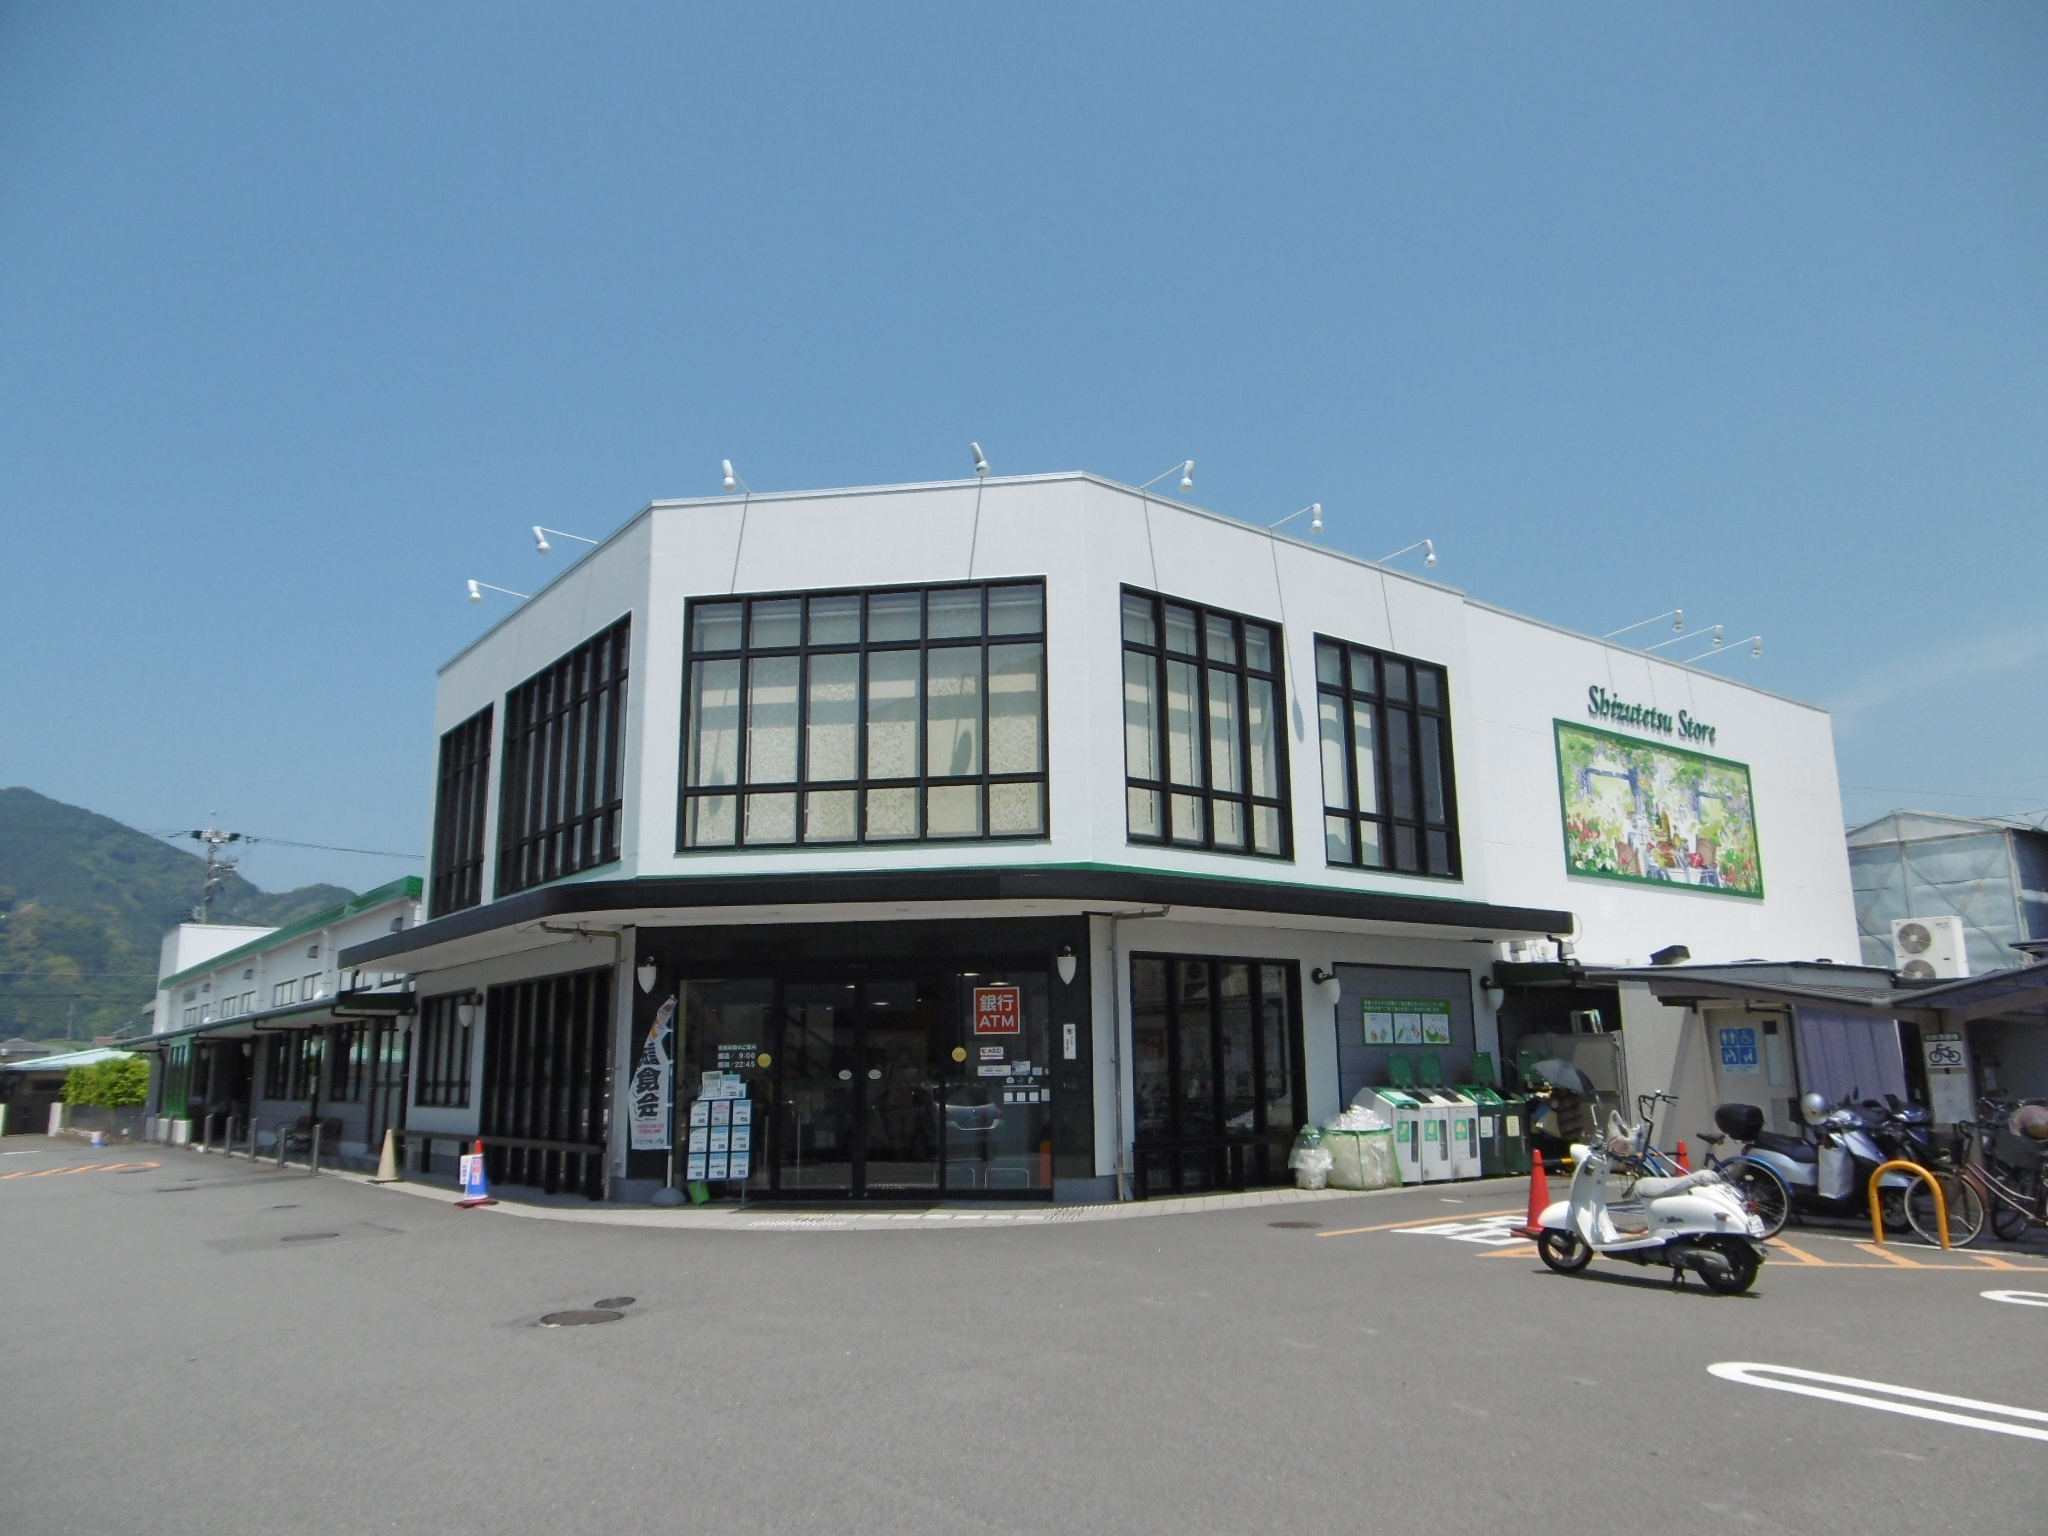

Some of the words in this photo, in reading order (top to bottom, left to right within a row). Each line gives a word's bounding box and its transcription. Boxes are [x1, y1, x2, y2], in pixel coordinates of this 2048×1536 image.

[1588, 685, 1673, 733] Shizutetsu
[1678, 709, 1716, 743] Store
[979, 994, 1014, 1012] 銀行
[979, 1014, 1015, 1028] ATM
[738, 1052, 756, 1060] 9:00
